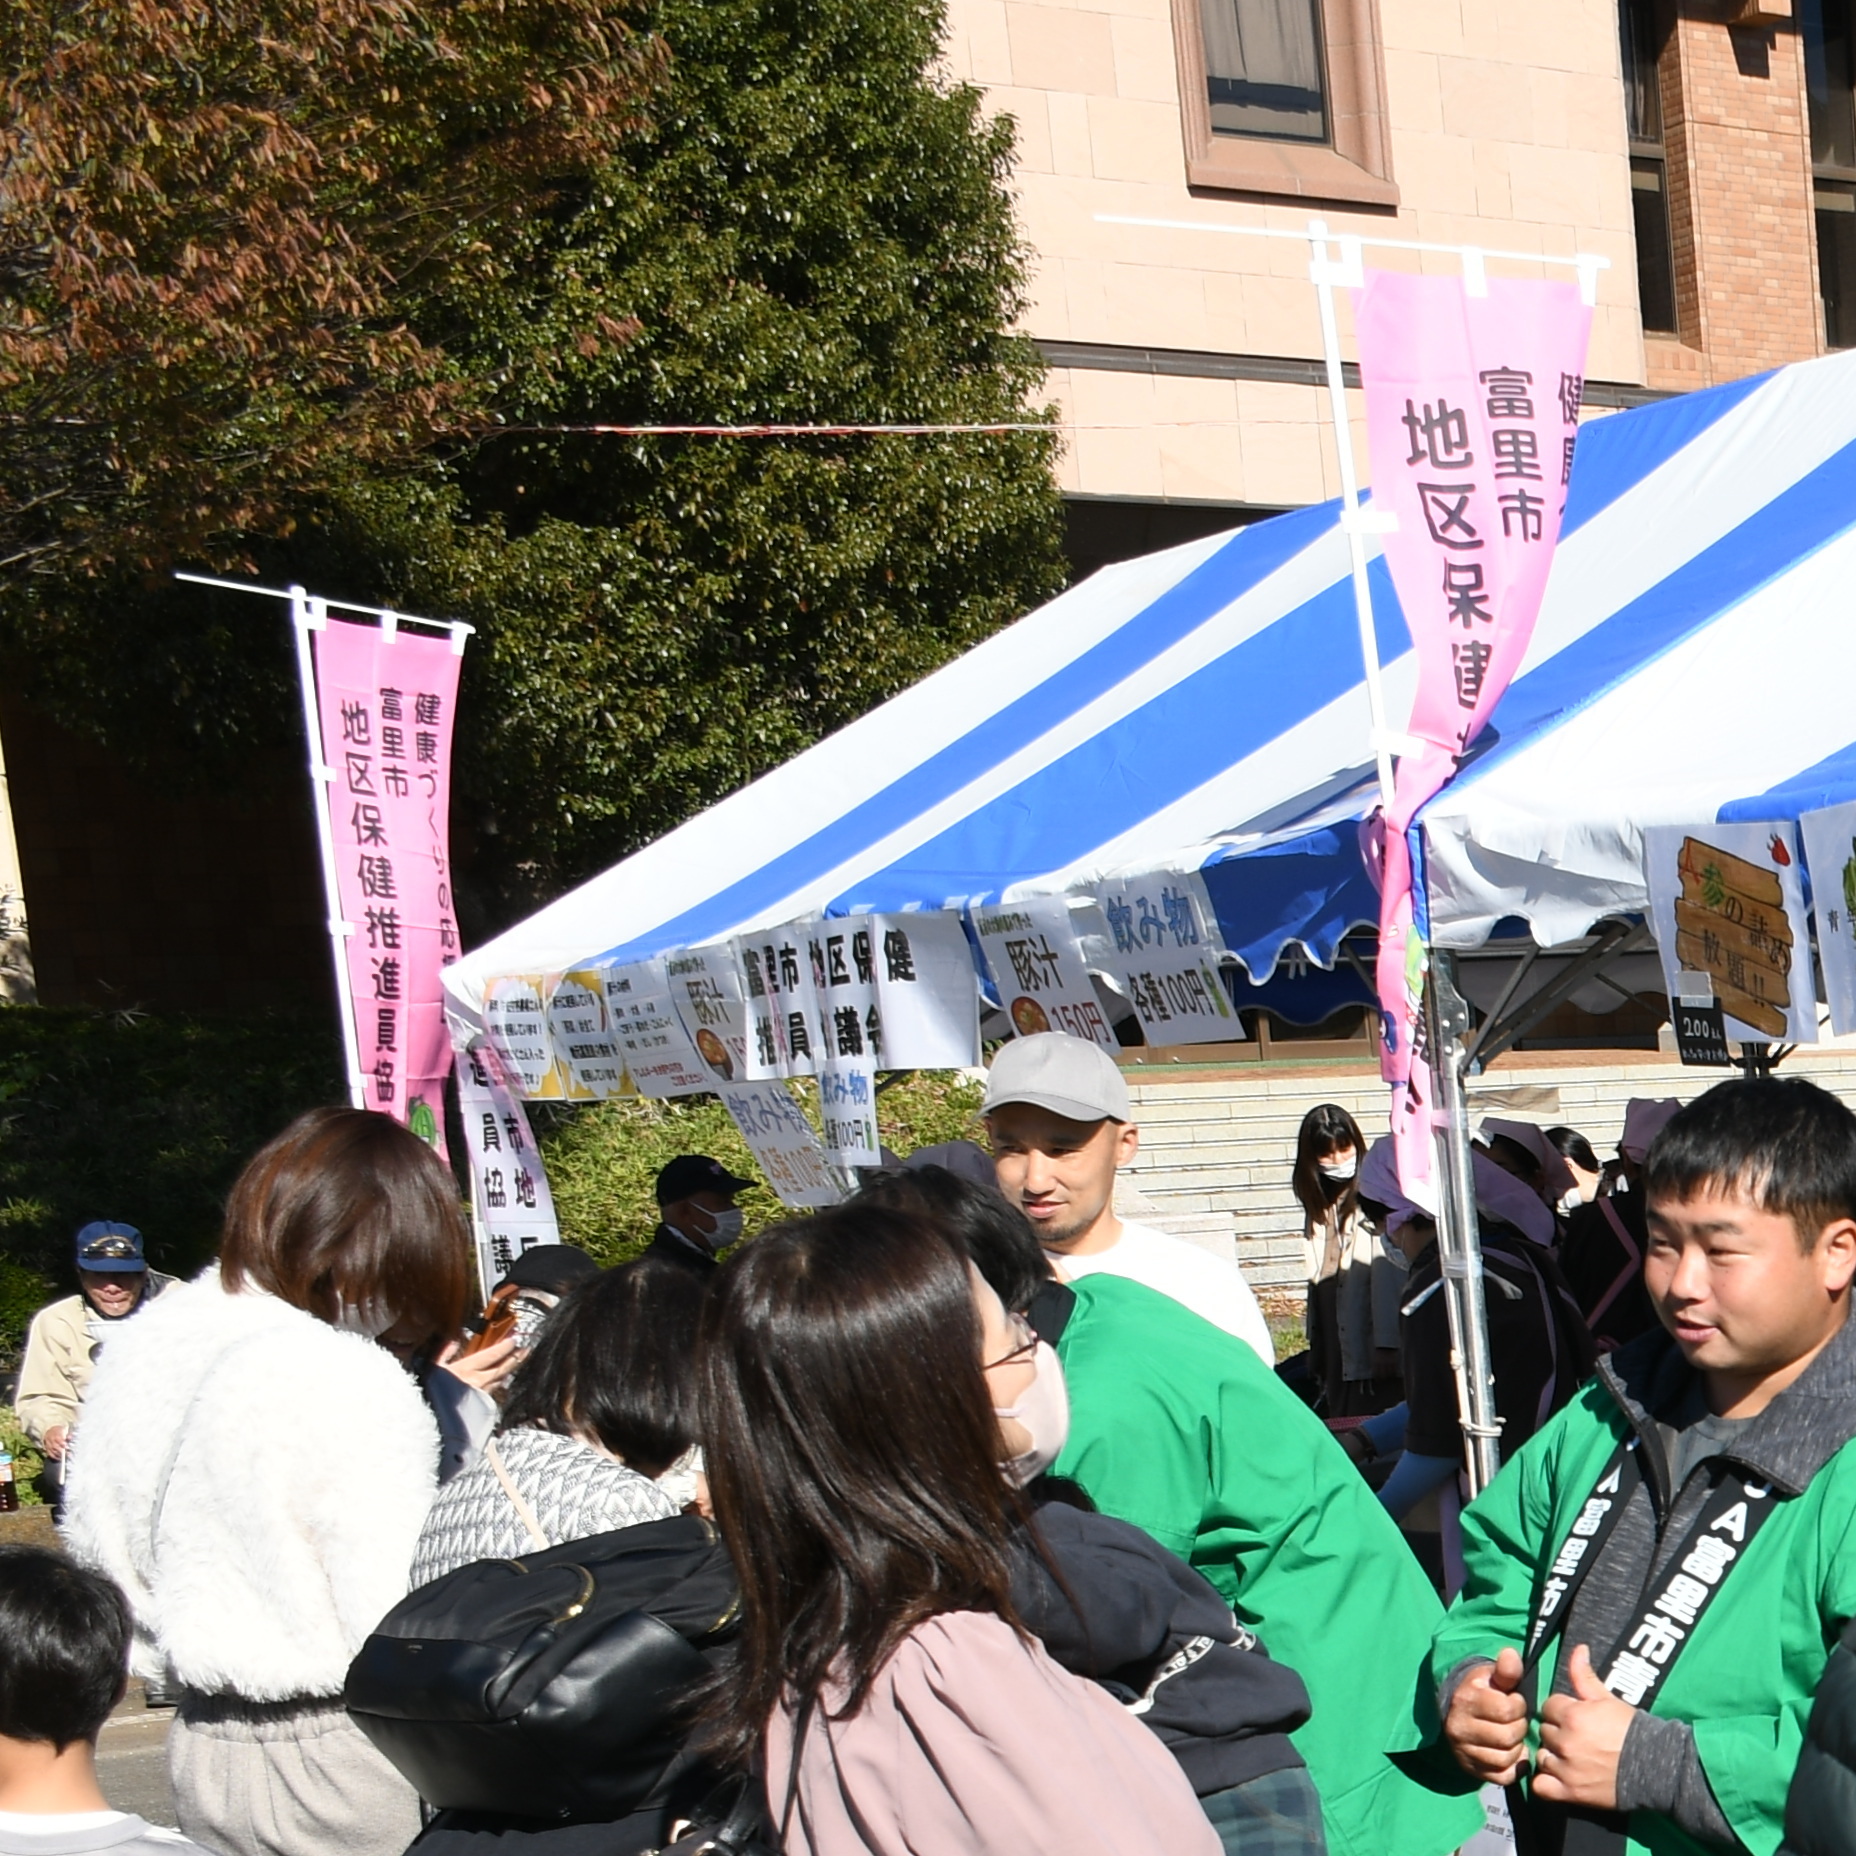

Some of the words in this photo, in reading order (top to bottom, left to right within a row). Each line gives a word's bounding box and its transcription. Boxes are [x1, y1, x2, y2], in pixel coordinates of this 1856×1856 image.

[1479, 365, 1545, 543] 富里市
[379, 687, 410, 798] 富里市
[341, 699, 404, 1120] 地区保健推進員協
[1106, 886, 1200, 954] 飲み物
[1005, 934, 1064, 992] 豚汁
[1128, 968, 1215, 1024] 各種100円
[1051, 1001, 1112, 1044] 150円
